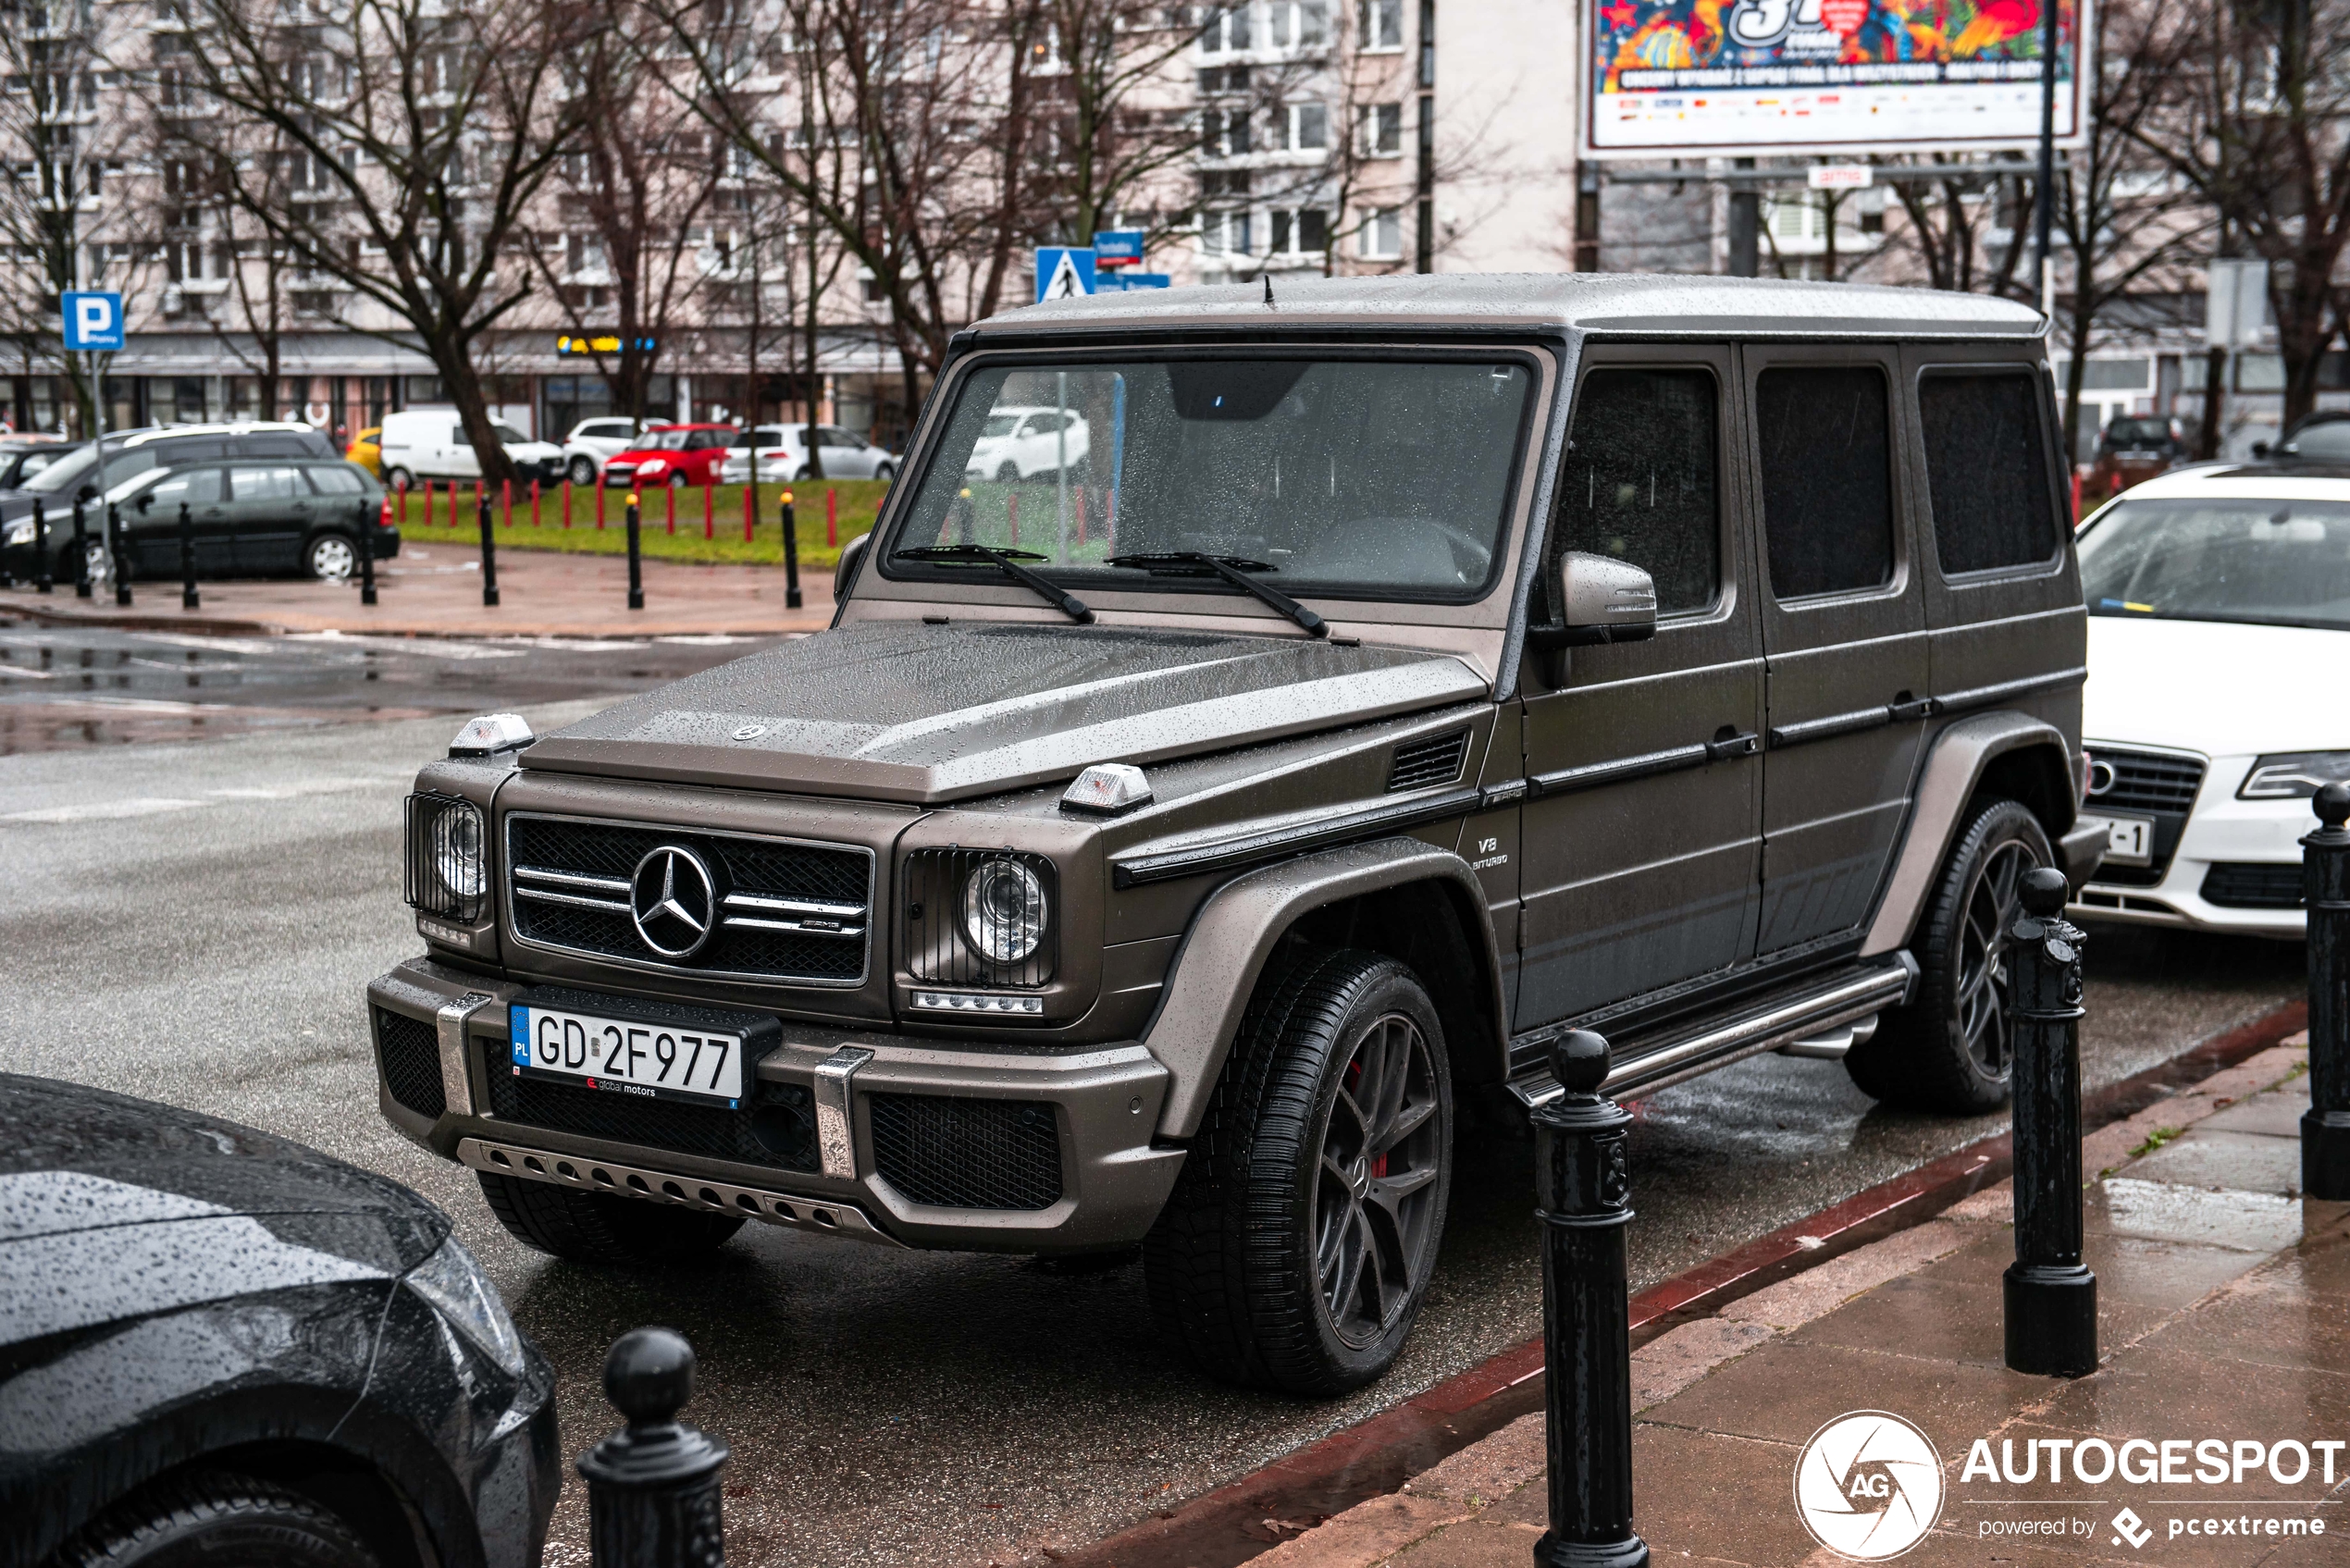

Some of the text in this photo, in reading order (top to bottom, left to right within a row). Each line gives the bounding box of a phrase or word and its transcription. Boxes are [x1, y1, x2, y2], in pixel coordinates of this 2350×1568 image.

[76, 297, 112, 343] P
[1478, 837, 1498, 854] V8
[1472, 854, 1508, 870] BITURBO
[514, 1042, 528, 1057] PL
[538, 1015, 729, 1090] GD 2F977
[599, 1080, 656, 1097] global motors
